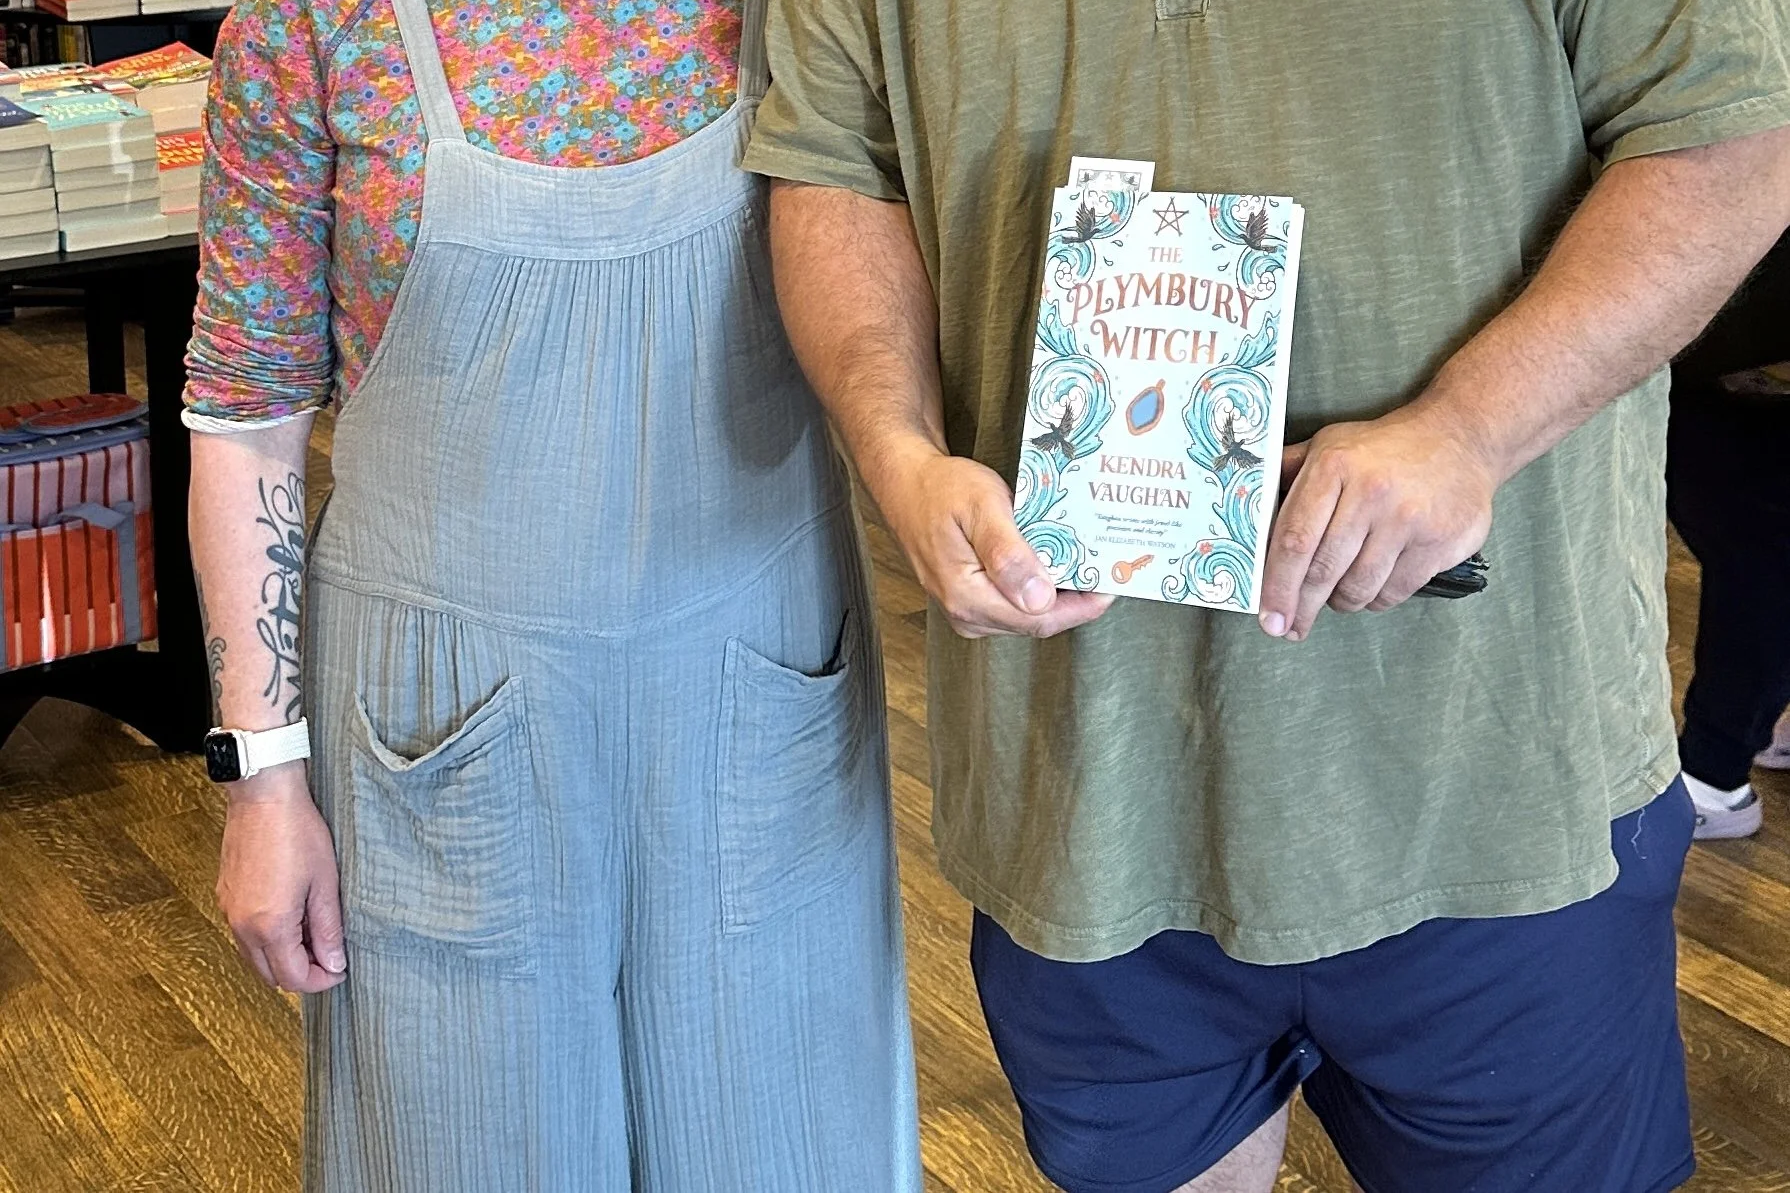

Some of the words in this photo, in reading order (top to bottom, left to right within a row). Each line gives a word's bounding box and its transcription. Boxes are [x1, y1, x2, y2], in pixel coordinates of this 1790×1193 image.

[1148, 246, 1184, 264] THE
[1066, 272, 1259, 331] PLYMBURY
[1090, 318, 1219, 365] WITCH
[1099, 454, 1187, 480] KENDRA
[1088, 481, 1193, 510] VAUGHAN
[1147, 539, 1177, 549] WATSON
